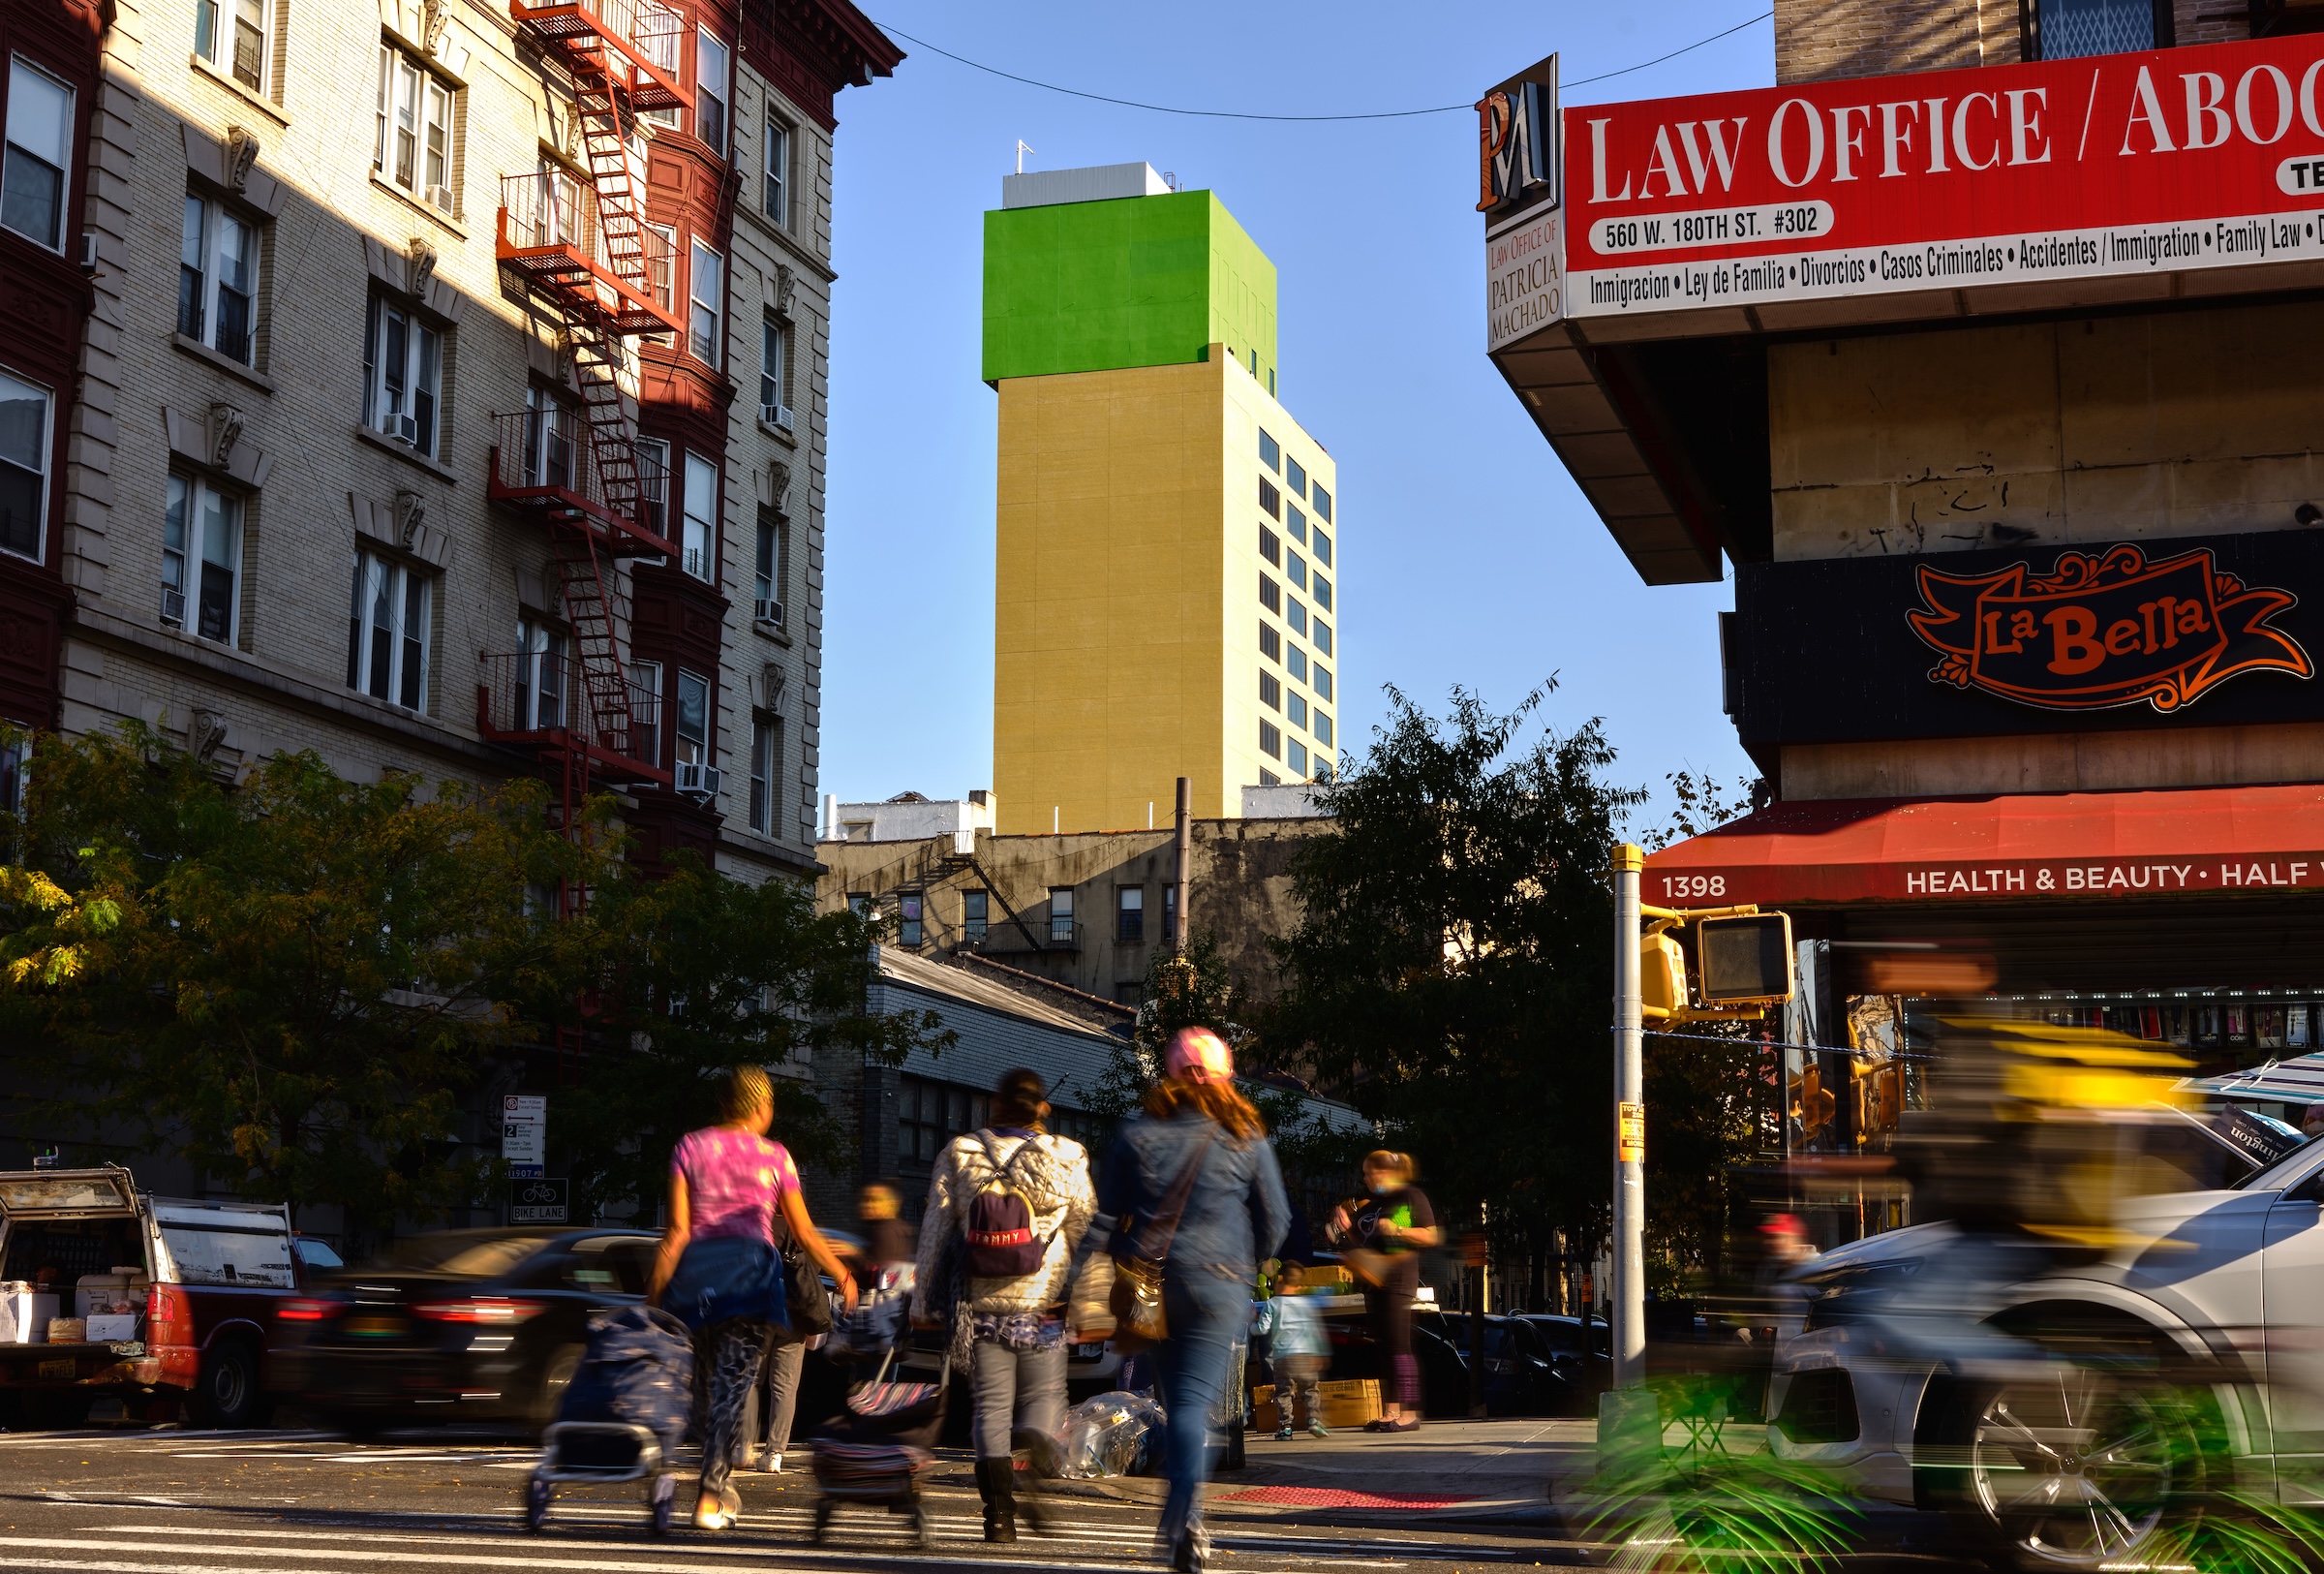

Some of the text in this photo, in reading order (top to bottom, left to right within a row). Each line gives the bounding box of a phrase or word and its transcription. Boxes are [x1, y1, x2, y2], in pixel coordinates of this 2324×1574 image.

[1587, 117, 1748, 204] LAW
[1767, 87, 2052, 188] OFFICE
[1490, 218, 1557, 271] LAW OFFICE OF
[1606, 206, 1818, 249] 560 W. 180TH ST. #302
[1491, 252, 1559, 311] PATRICIA
[1591, 269, 1669, 308] Inmigracion
[1685, 266, 1708, 302] Ley
[1713, 264, 1728, 294] de
[1733, 260, 1785, 292] Familia
[1801, 254, 1865, 288] Divorcios
[1881, 249, 1922, 281] Casos
[1927, 241, 2003, 278] Criminales
[2019, 233, 2097, 269] Accidentes
[2111, 227, 2200, 266] Immigration
[2216, 219, 2266, 258] Family
[2271, 217, 2301, 249] Law
[1491, 288, 1560, 344] MACHADO
[1982, 596, 2211, 676] La Bella
[1662, 875, 1727, 898] 1398
[1907, 869, 2025, 893] HEALTH
[2035, 868, 2056, 890] &
[2065, 865, 2192, 889] BEAUTY
[2221, 862, 2309, 886] HALF
[506, 1126, 514, 1136] 2
[514, 1207, 564, 1219] BIKE LANE
